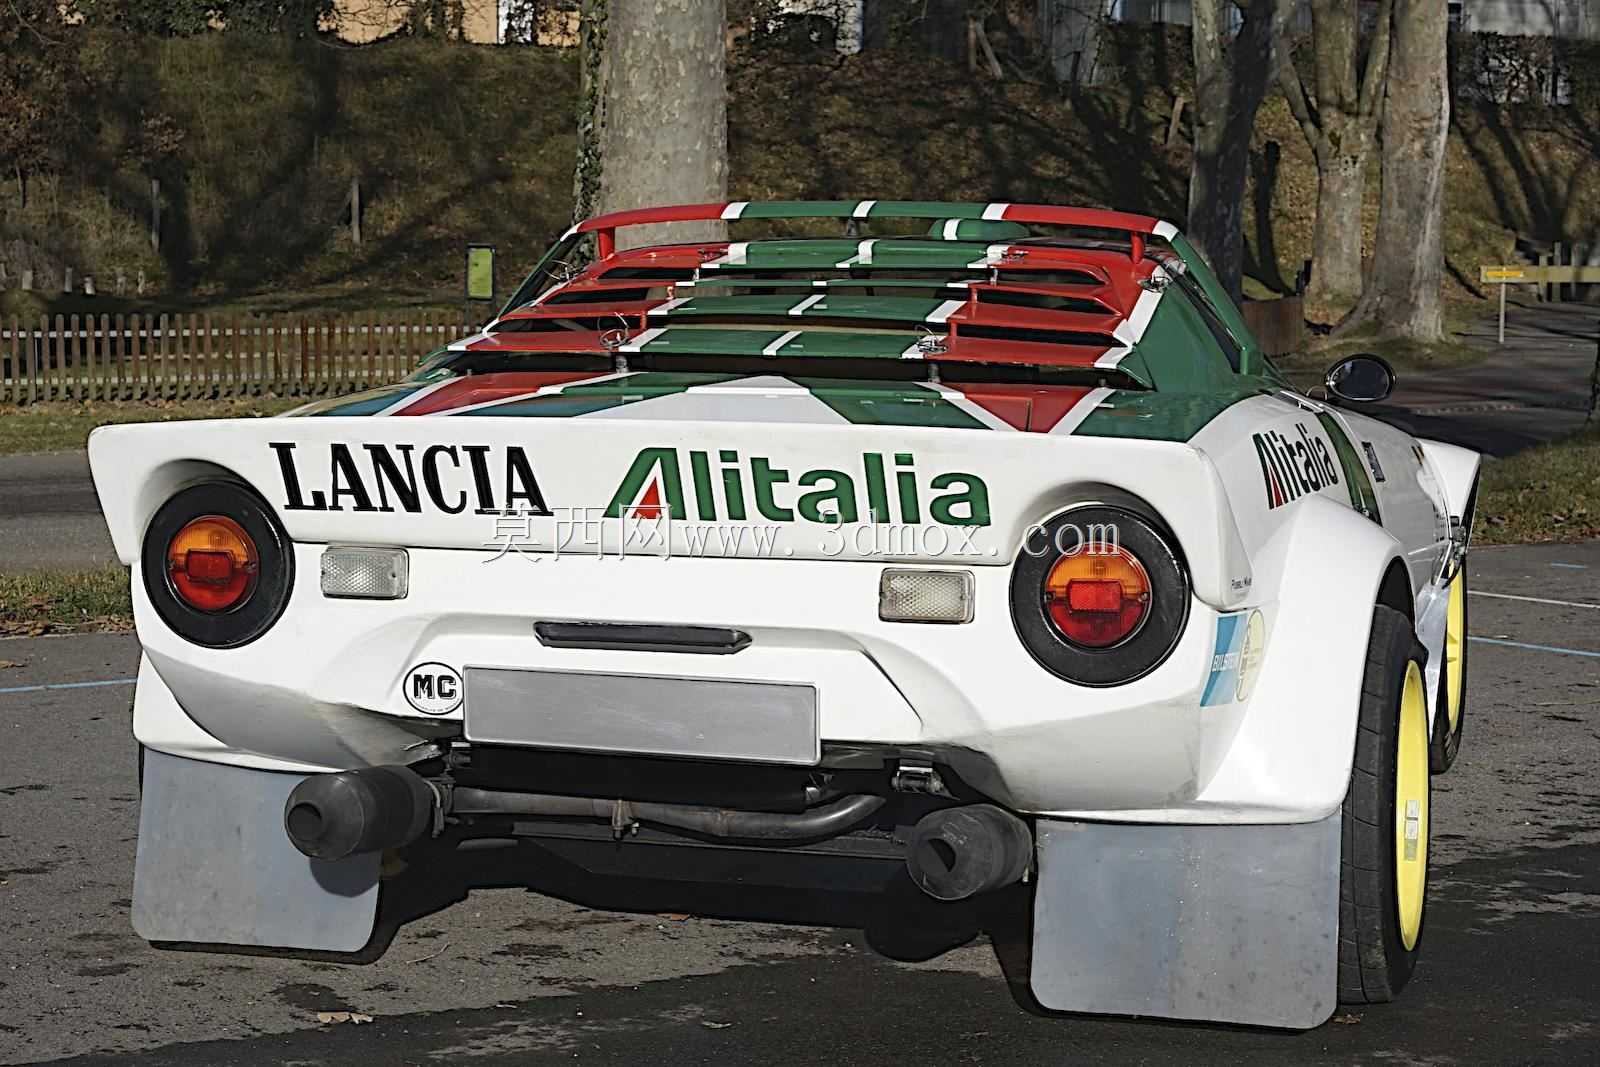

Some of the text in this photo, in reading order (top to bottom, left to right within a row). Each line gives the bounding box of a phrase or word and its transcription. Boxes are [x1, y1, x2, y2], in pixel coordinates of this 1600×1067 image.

[268, 442, 554, 517] LANCIA
[603, 446, 991, 527] Alitalia
[1252, 422, 1339, 510] Alitalia
[413, 673, 457, 700] MC
